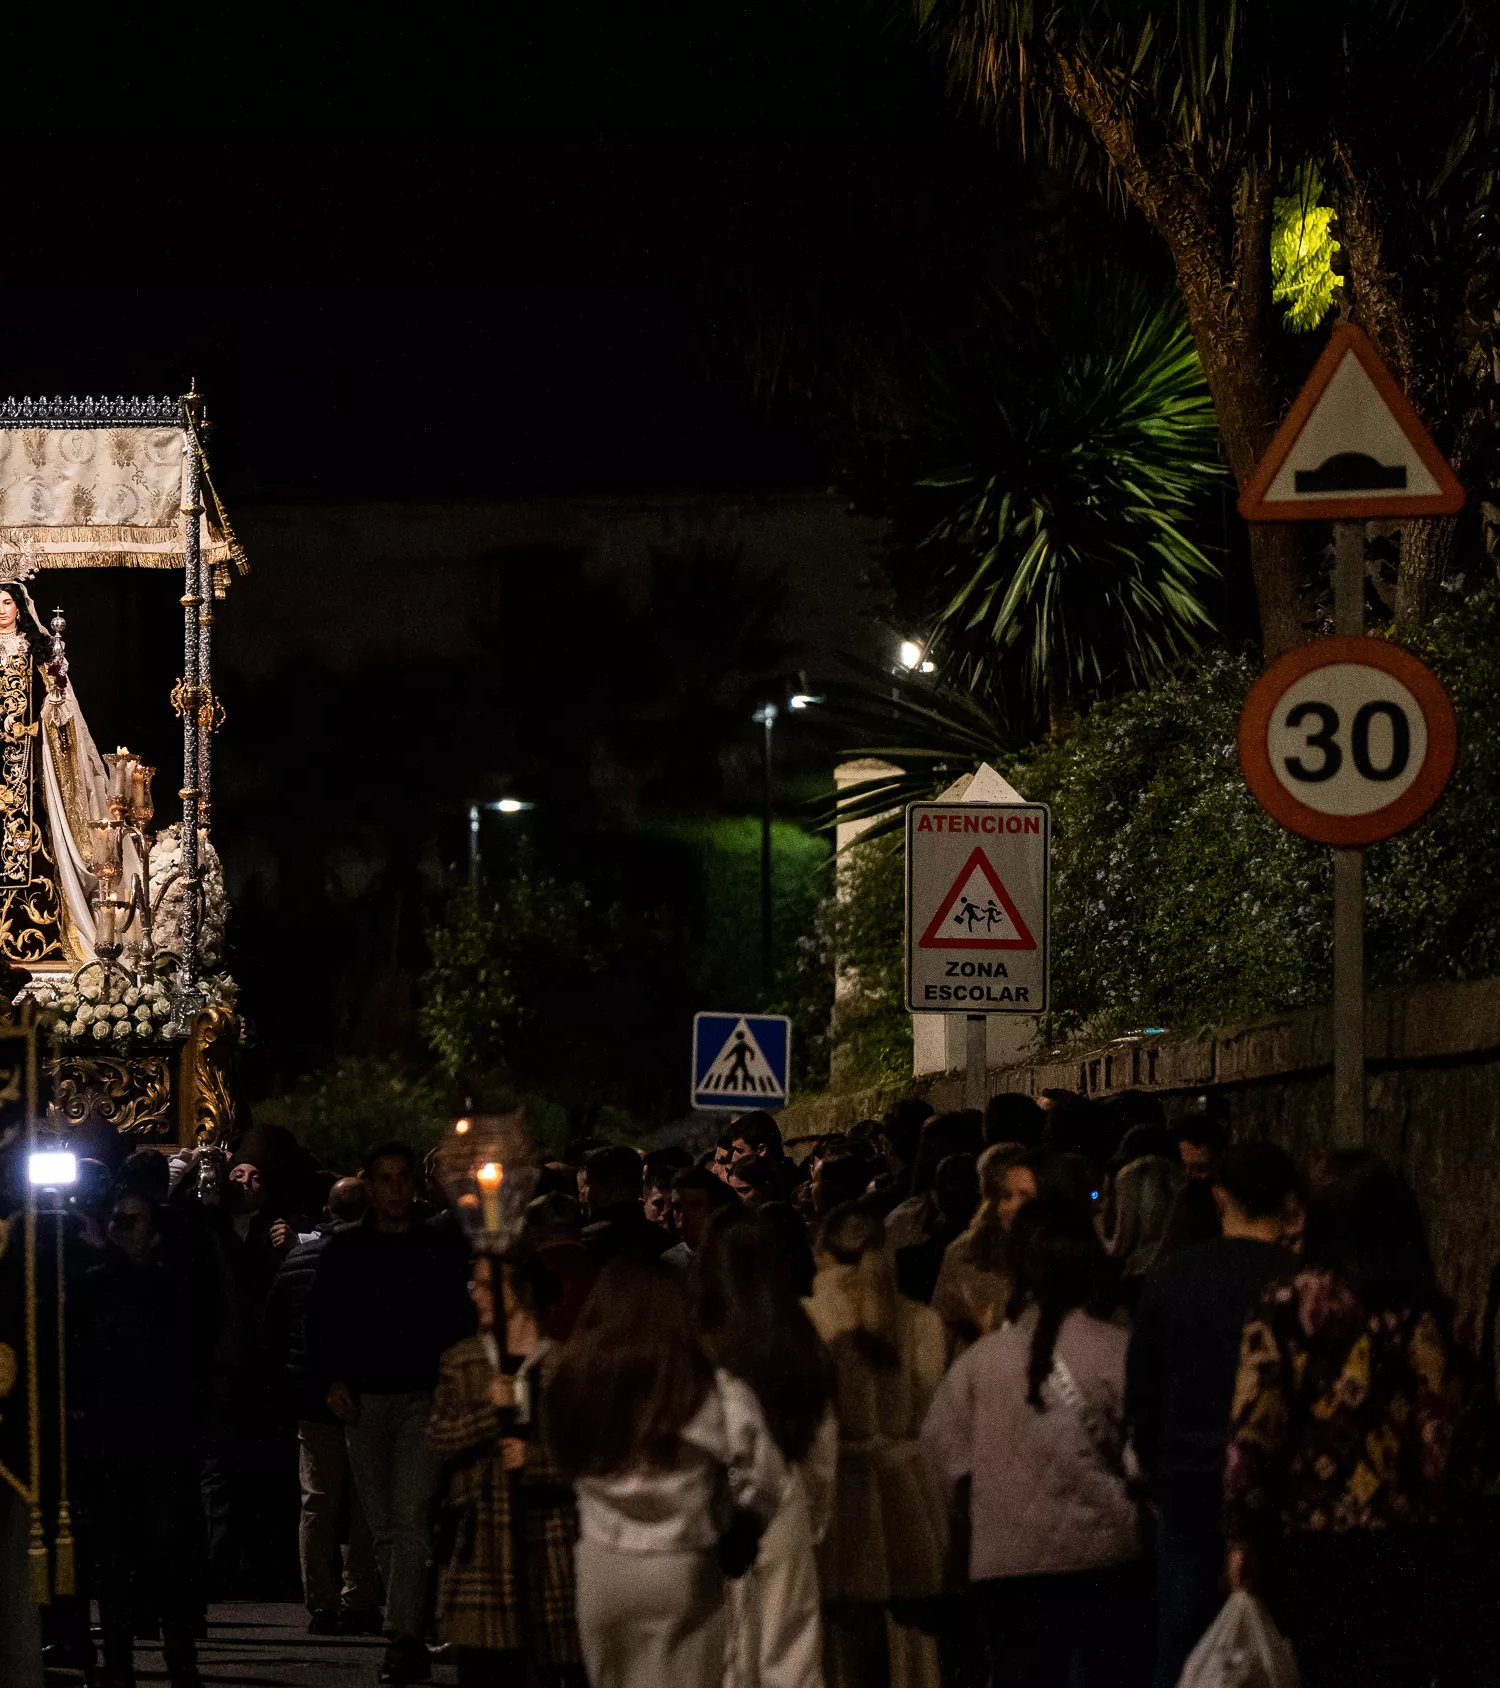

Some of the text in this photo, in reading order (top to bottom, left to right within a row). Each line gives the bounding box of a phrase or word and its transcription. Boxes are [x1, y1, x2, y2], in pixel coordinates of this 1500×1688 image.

[1284, 700, 1410, 783] 30
[917, 815, 1040, 835] ATENCION
[945, 961, 1008, 978] ZONA
[924, 985, 1029, 1002] ESCOLAR
